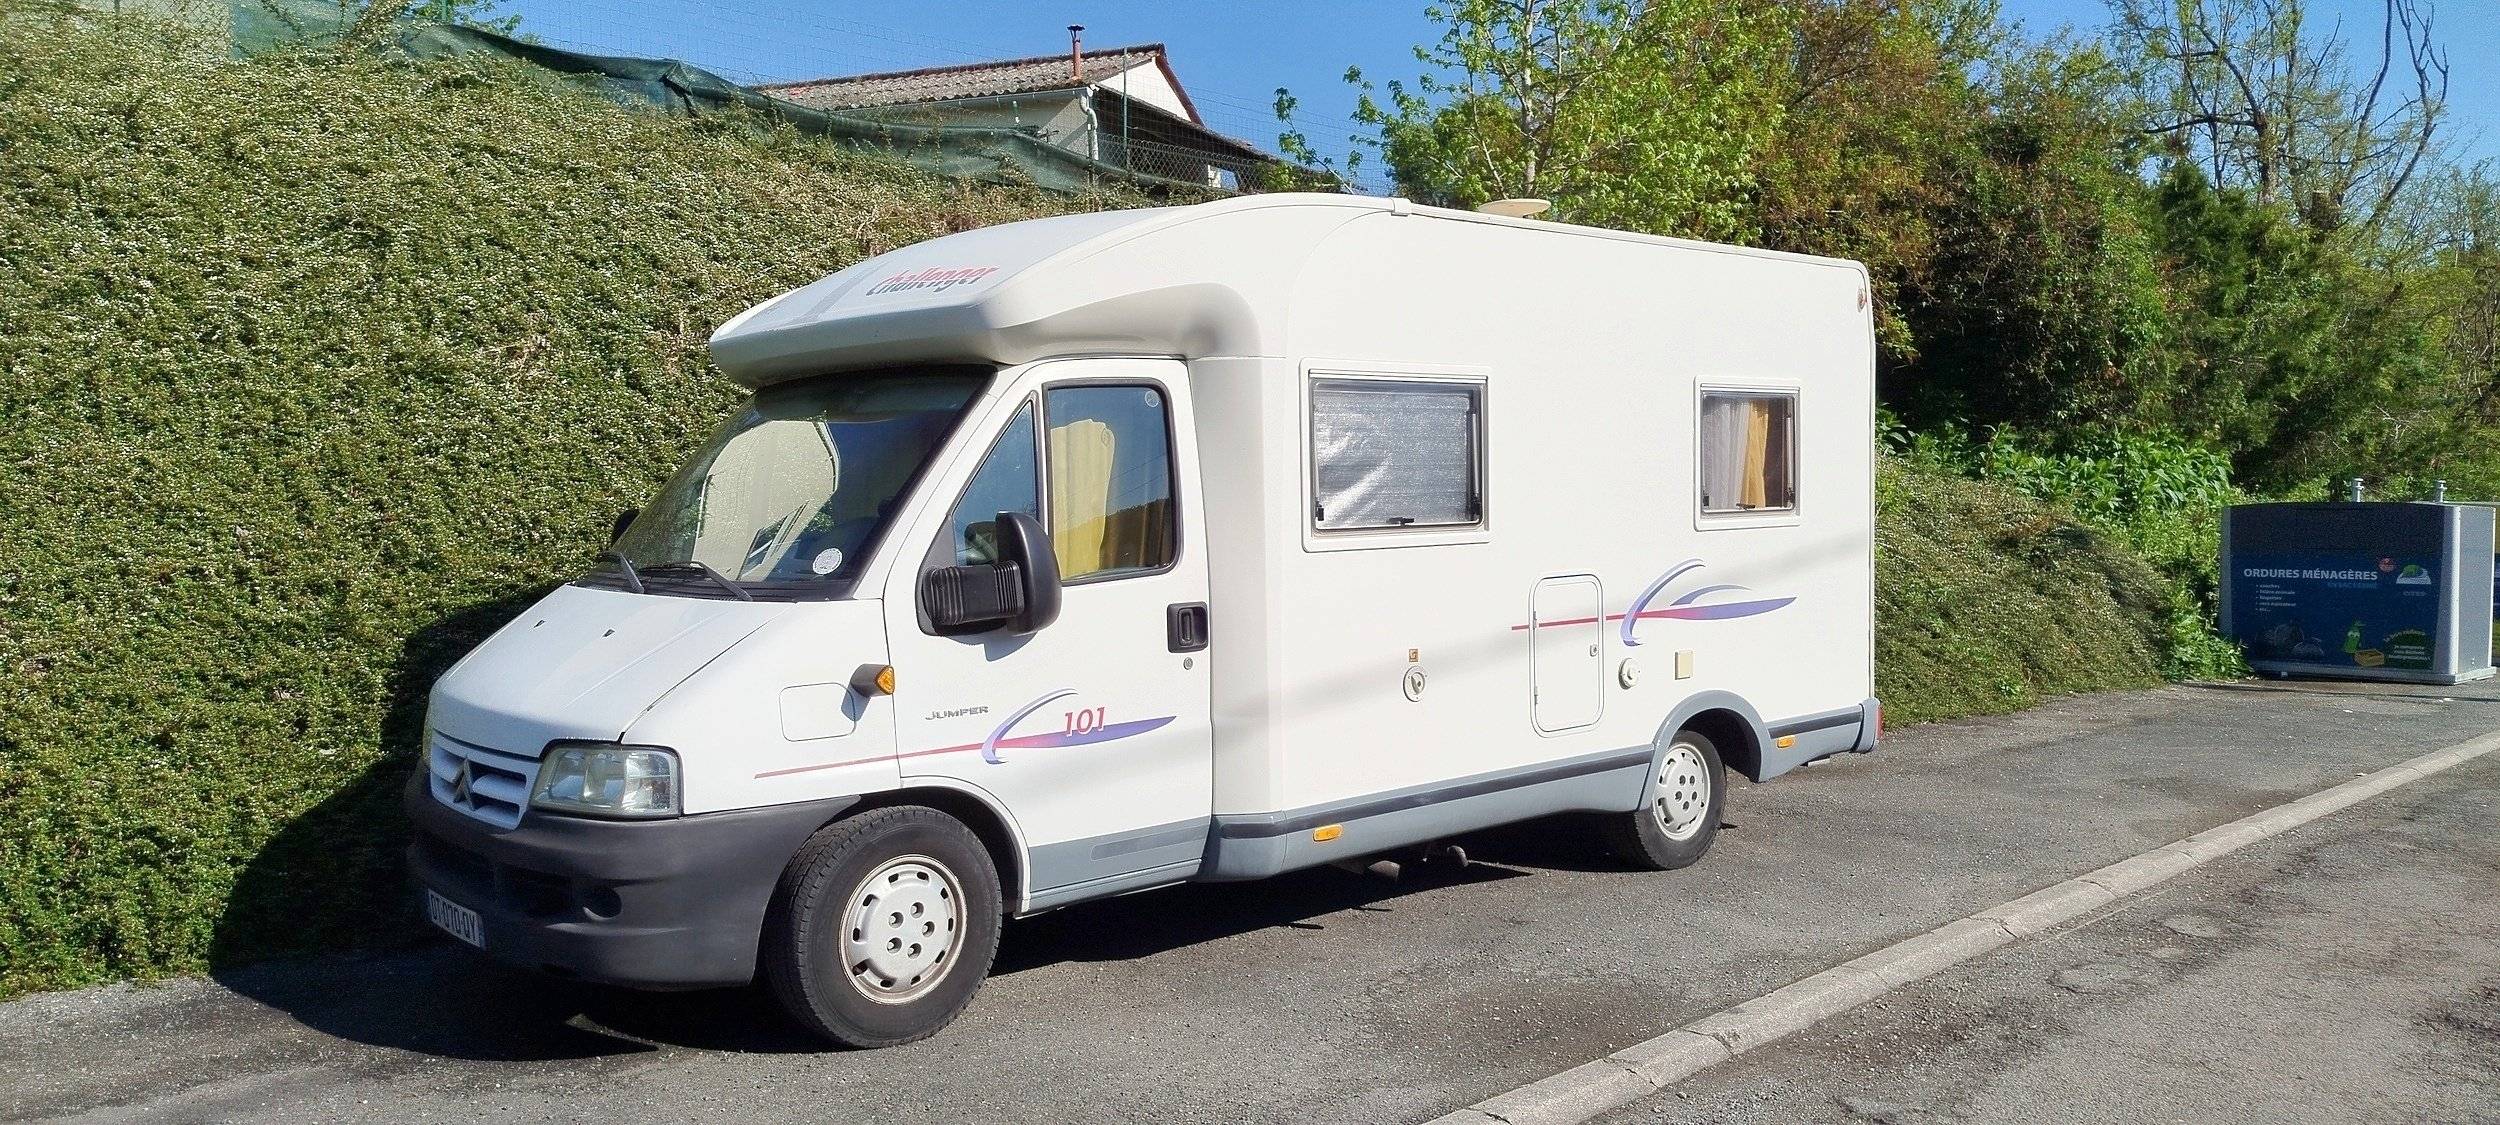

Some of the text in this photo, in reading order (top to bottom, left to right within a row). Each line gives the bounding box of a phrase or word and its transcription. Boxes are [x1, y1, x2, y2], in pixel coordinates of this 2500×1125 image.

[2243, 567, 2379, 581] ORDURES MÉNAGÈRES
[925, 705, 989, 721] JUMPER
[1064, 705, 1106, 738] 101
